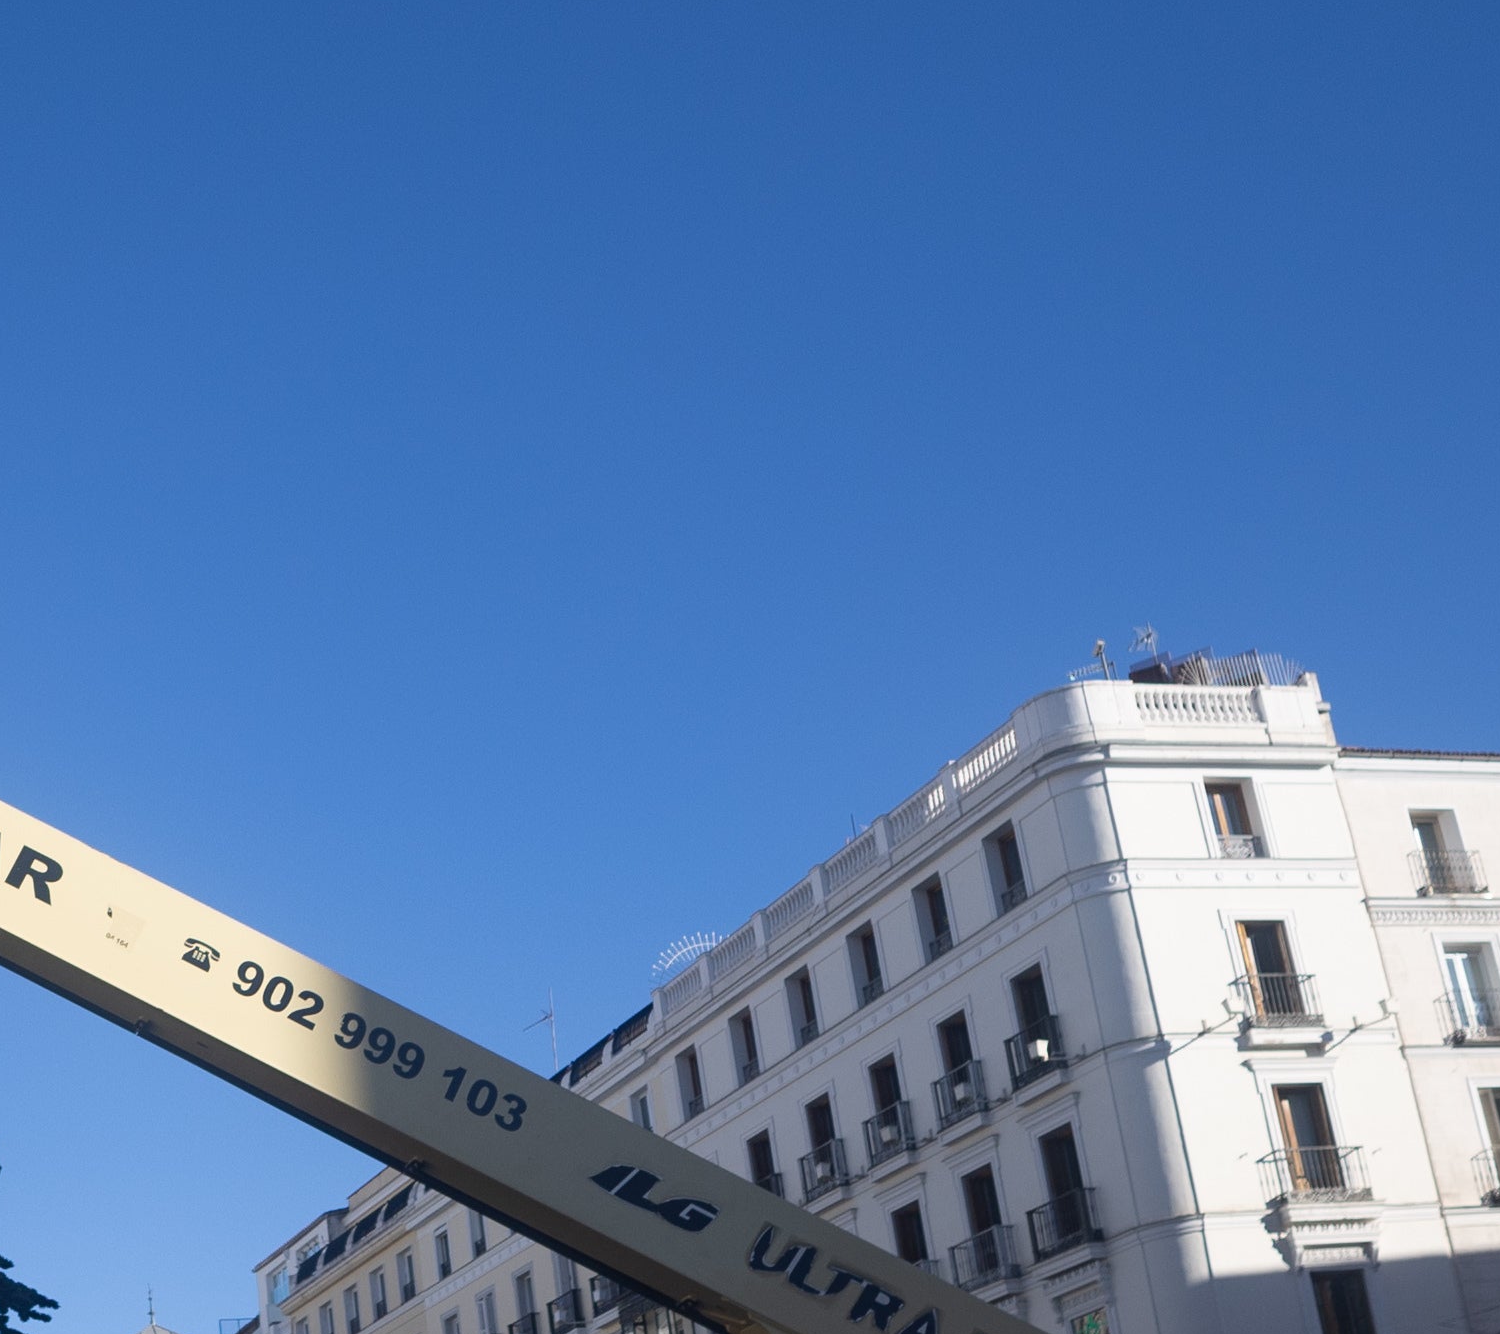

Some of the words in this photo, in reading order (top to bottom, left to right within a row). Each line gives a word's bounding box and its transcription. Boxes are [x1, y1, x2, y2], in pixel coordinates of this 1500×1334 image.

[232, 960, 326, 1031] 902
[334, 1012, 425, 1079] 999
[442, 1066, 528, 1132] 103
